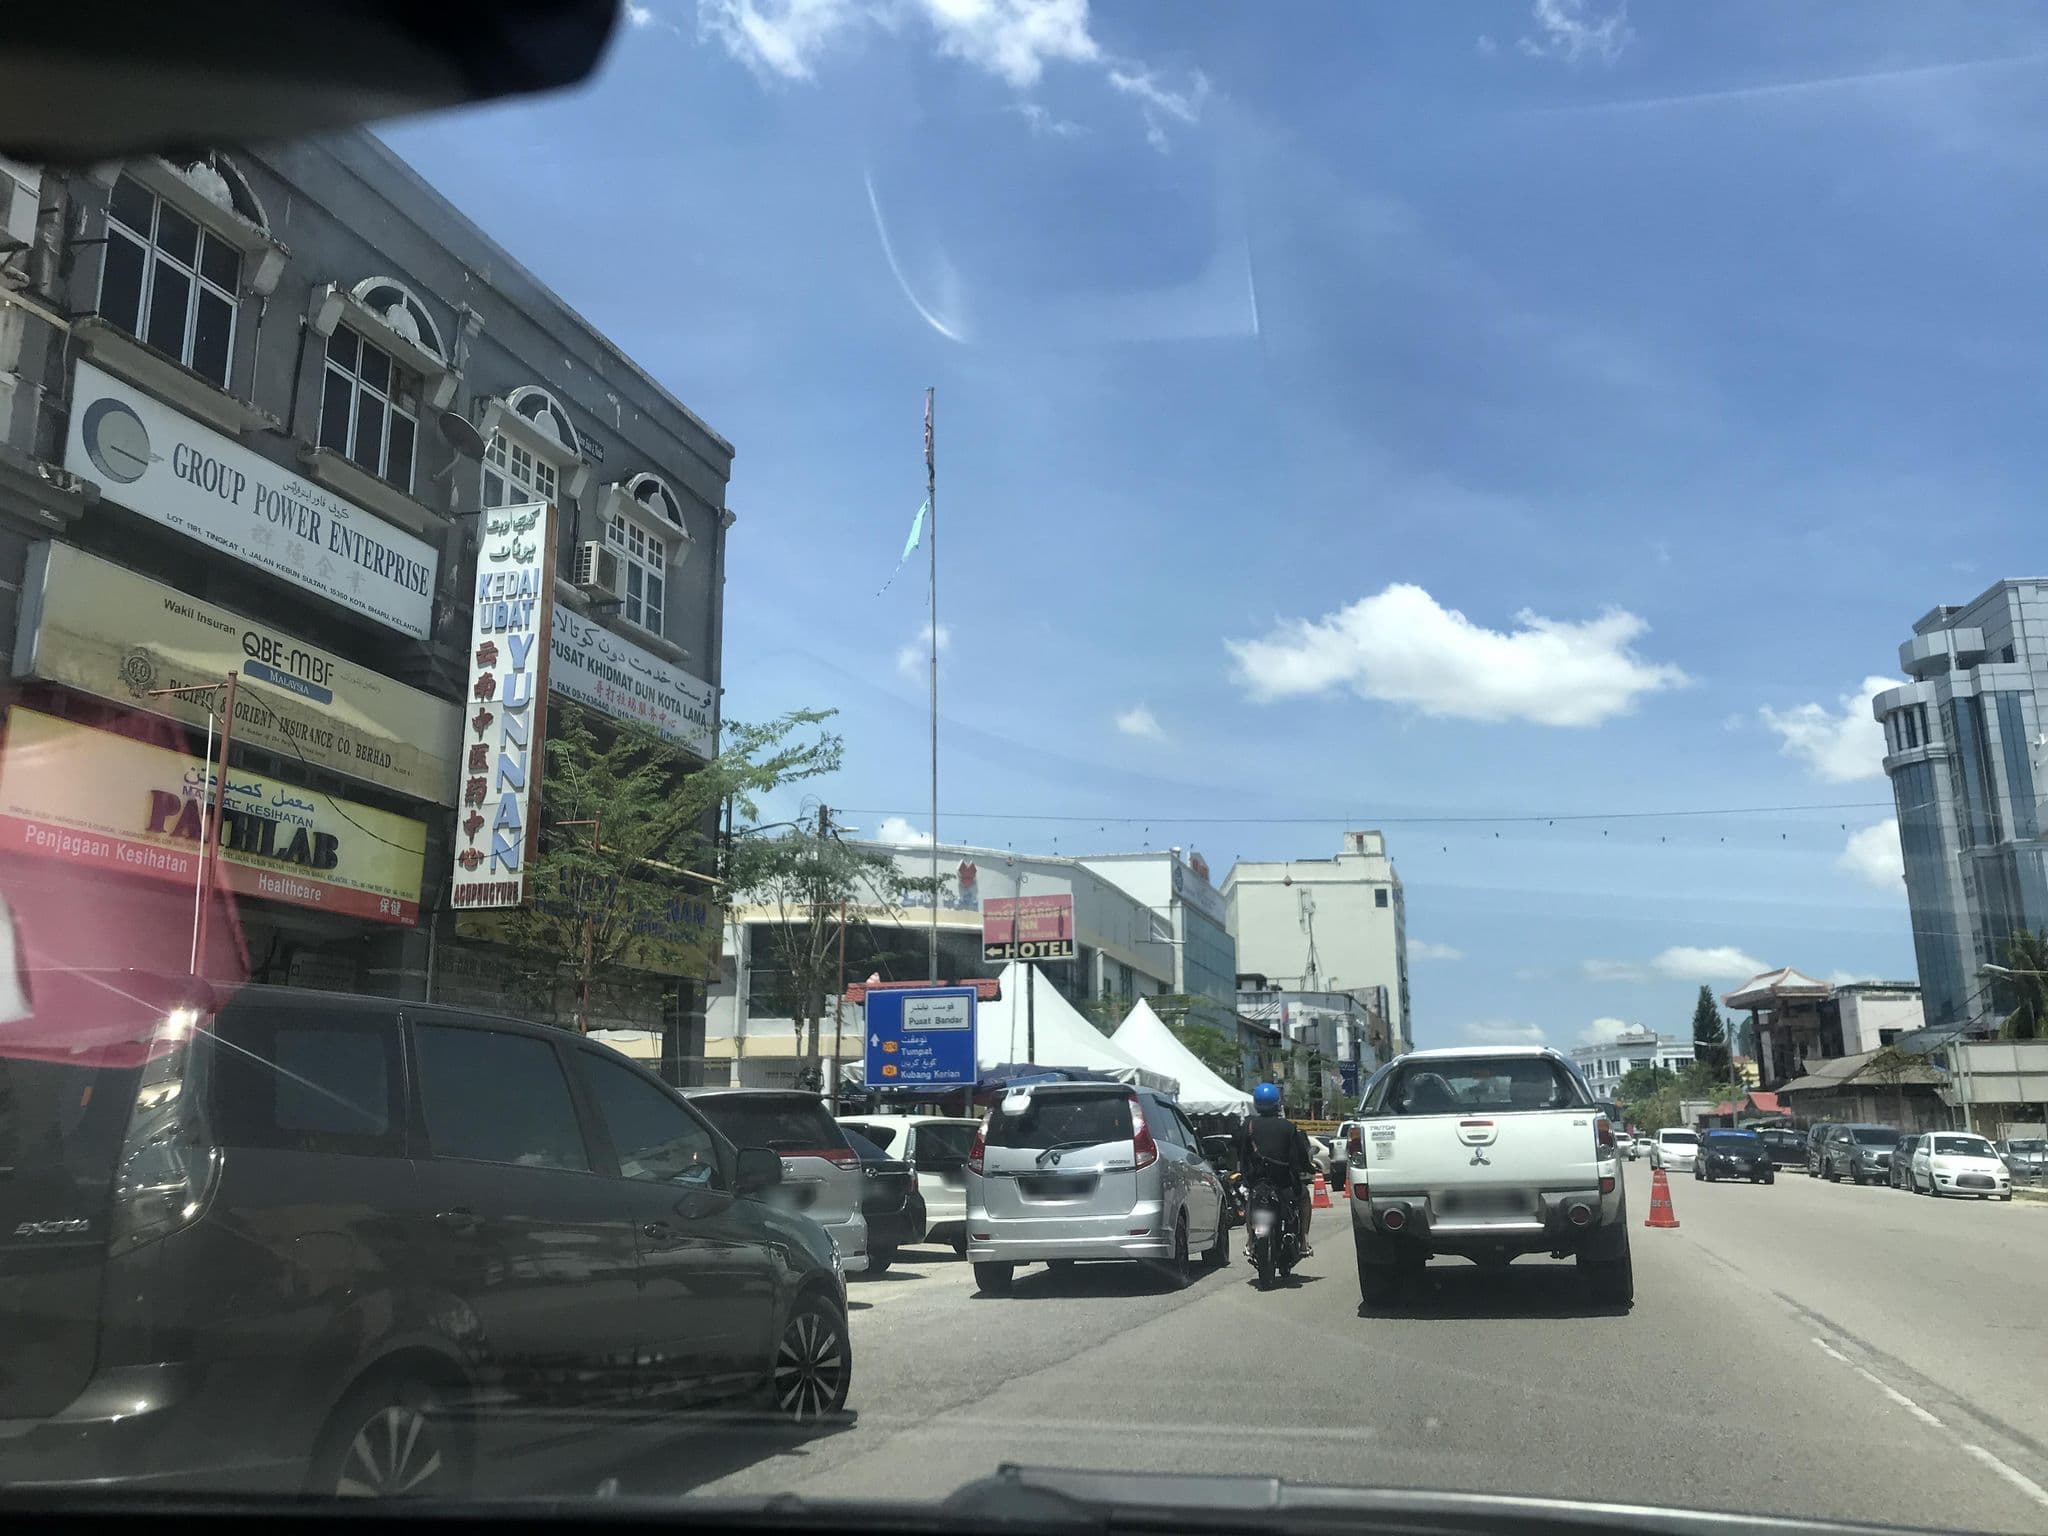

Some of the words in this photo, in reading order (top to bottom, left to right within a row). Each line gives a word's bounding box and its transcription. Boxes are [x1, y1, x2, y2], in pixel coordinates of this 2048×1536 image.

[173, 443, 246, 505] GROUP
[253, 481, 321, 545] POWER
[328, 520, 430, 596] ENTERPRISE
[167, 513, 183, 525] LOT
[205, 531, 239, 551] TINGKAT
[249, 552, 274, 567] JALAN
[276, 561, 300, 579] KEBUN
[349, 597, 366, 610] KOTA
[479, 567, 540, 603] KEDAI
[164, 599, 194, 619] Wakil
[197, 612, 236, 635] Insuran
[480, 600, 535, 634] UBAT
[270, 670, 310, 695] MALAYSIA
[557, 682, 571, 695] FAX
[588, 656, 633, 692] KHIDMAT
[635, 681, 656, 703] DUN
[658, 694, 681, 716] KOTA
[683, 704, 707, 728] LAMA
[235, 701, 274, 729] ORIENT
[279, 716, 334, 749] INSURANCE
[337, 738, 352, 756] CO.
[356, 743, 392, 768] BERHAD
[490, 633, 534, 875] YUNNAN
[145, 790, 339, 869] PATHLAB
[245, 803, 313, 828] KESIHATAN
[25, 824, 109, 857] Penjagaan
[116, 843, 188, 873] Kesihatan
[259, 873, 321, 901] Healthcare
[453, 881, 519, 906] ACUPUNCTURE
[380, 897, 401, 917] 保健
[1005, 941, 1072, 958] HOTEL
[909, 1016, 931, 1025] Pusat
[935, 1016, 963, 1025] Bandar
[901, 1047, 933, 1057] Tumpat
[900, 1070, 932, 1080] Kubang
[933, 1069, 961, 1079] Kerian
